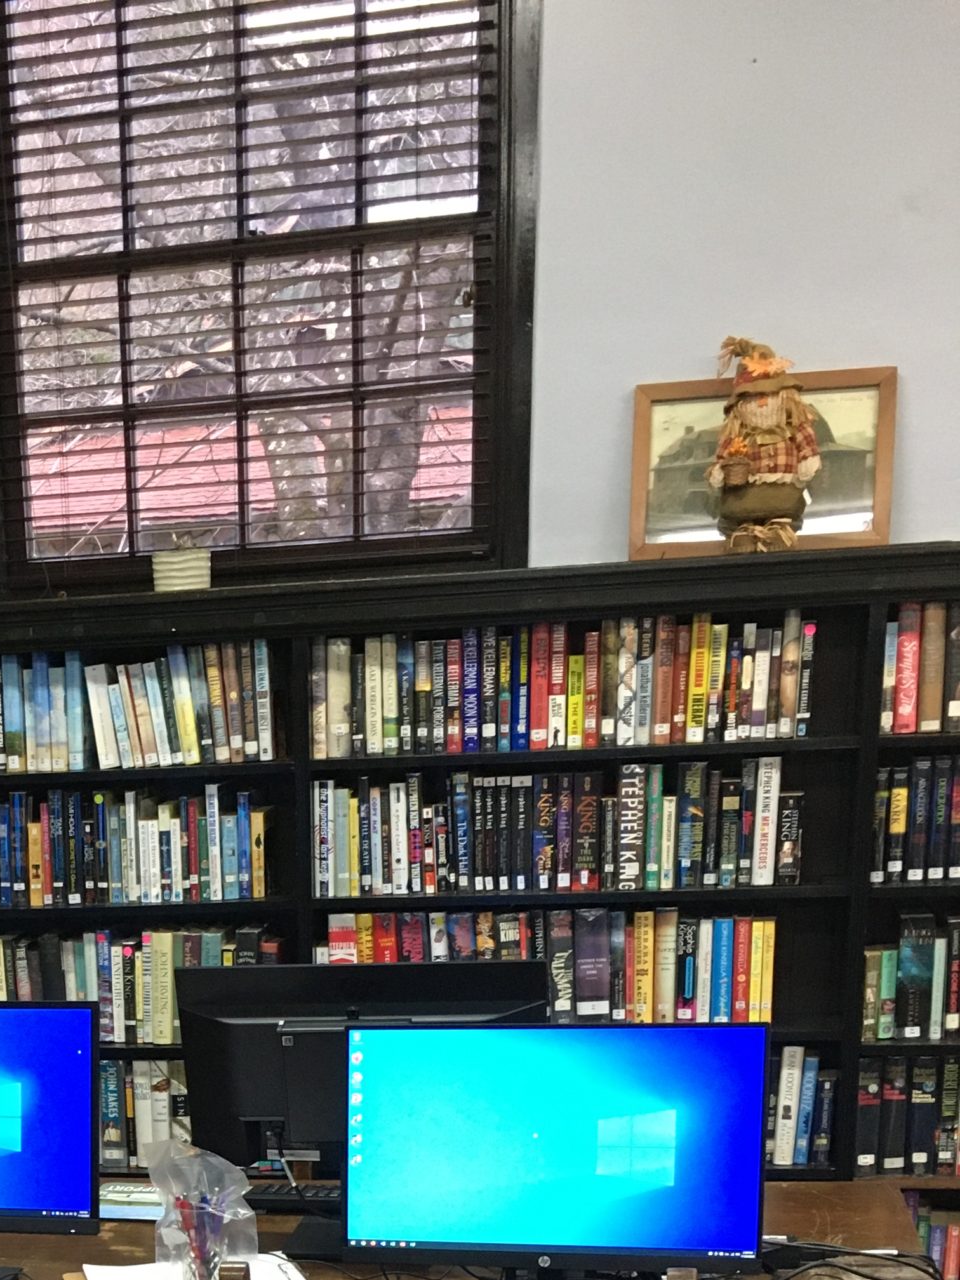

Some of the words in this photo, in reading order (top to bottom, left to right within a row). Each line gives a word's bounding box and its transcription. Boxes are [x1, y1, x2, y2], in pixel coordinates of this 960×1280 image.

[447, 645, 458, 663] FAYE
[642, 633, 652, 657] DEATH
[464, 647, 477, 689] KELLERMAN
[482, 648, 496, 696] KELLERMAN
[552, 653, 564, 684] KELLERMAN
[586, 654, 598, 691] KELLERMAN
[694, 651, 705, 688] KELLERMAN
[897, 636, 918, 689] Scruples
[433, 662, 444, 698] KELLERMAN
[447, 664, 460, 707] KELLERMAN
[640, 662, 650, 694] jonathan
[801, 668, 811, 689] THOMAS
[464, 693, 478, 716] MOON
[571, 702, 579, 717] THE
[640, 695, 650, 728] kellerma
[433, 706, 444, 744] FORGOEN
[571, 719, 579, 736] WEB
[691, 764, 701, 799] STEPHEN
[762, 762, 773, 794] STEPHEN
[320, 787, 328, 801] the
[408, 777, 419, 811] STEPHEN
[559, 790, 571, 813] KING
[620, 764, 639, 844] STEPHEN
[761, 796, 770, 814] KING
[936, 777, 947, 825] DESECRATION
[318, 802, 328, 839] hypnotist
[410, 811, 420, 830] KING
[485, 814, 493, 830] King
[499, 813, 508, 829] King
[517, 814, 526, 830] King
[537, 793, 553, 827] KING
[577, 795, 597, 834] KING
[890, 792, 900, 825] MARK
[55, 816, 63, 835] TAMI
[68, 814, 76, 837] HOAG
[361, 819, 369, 836] TILL
[423, 823, 432, 844] KING
[457, 820, 467, 837] The
[474, 815, 482, 831] King
[694, 822, 704, 843] FOUR
[781, 809, 792, 841] KING
[791, 809, 799, 840] STEPHEN
[320, 843, 329, 859] lars
[458, 836, 467, 856] Dark
[677, 822, 691, 861] MIDNIGHT
[693, 843, 703, 861] PAST
[758, 832, 770, 870] MERCEDES
[458, 856, 468, 874] Half
[401, 925, 411, 956] KING
[500, 929, 520, 942] KING
[677, 924, 687, 955] Kinsella
[685, 925, 696, 954] Sophie
[738, 921, 746, 943] SOPHIE
[15, 947, 26, 960] THE
[160, 949, 168, 978] JOHN
[737, 944, 745, 974] KINSELLA
[124, 974, 134, 999] KING
[551, 949, 573, 1002] TALISMAN
[565, 968, 573, 981] THE
[159, 980, 168, 1015] IRVING
[787, 1051, 799, 1071] DEAN
[106, 1066, 117, 1092] JOHN
[784, 1072, 797, 1102] KOONTZ
[942, 1064, 959, 1090] ROBERT
[802, 1071, 816, 1111] KOONTZ
[941, 1090, 959, 1117] LUDLUM
[108, 1092, 119, 1118] JAKES
